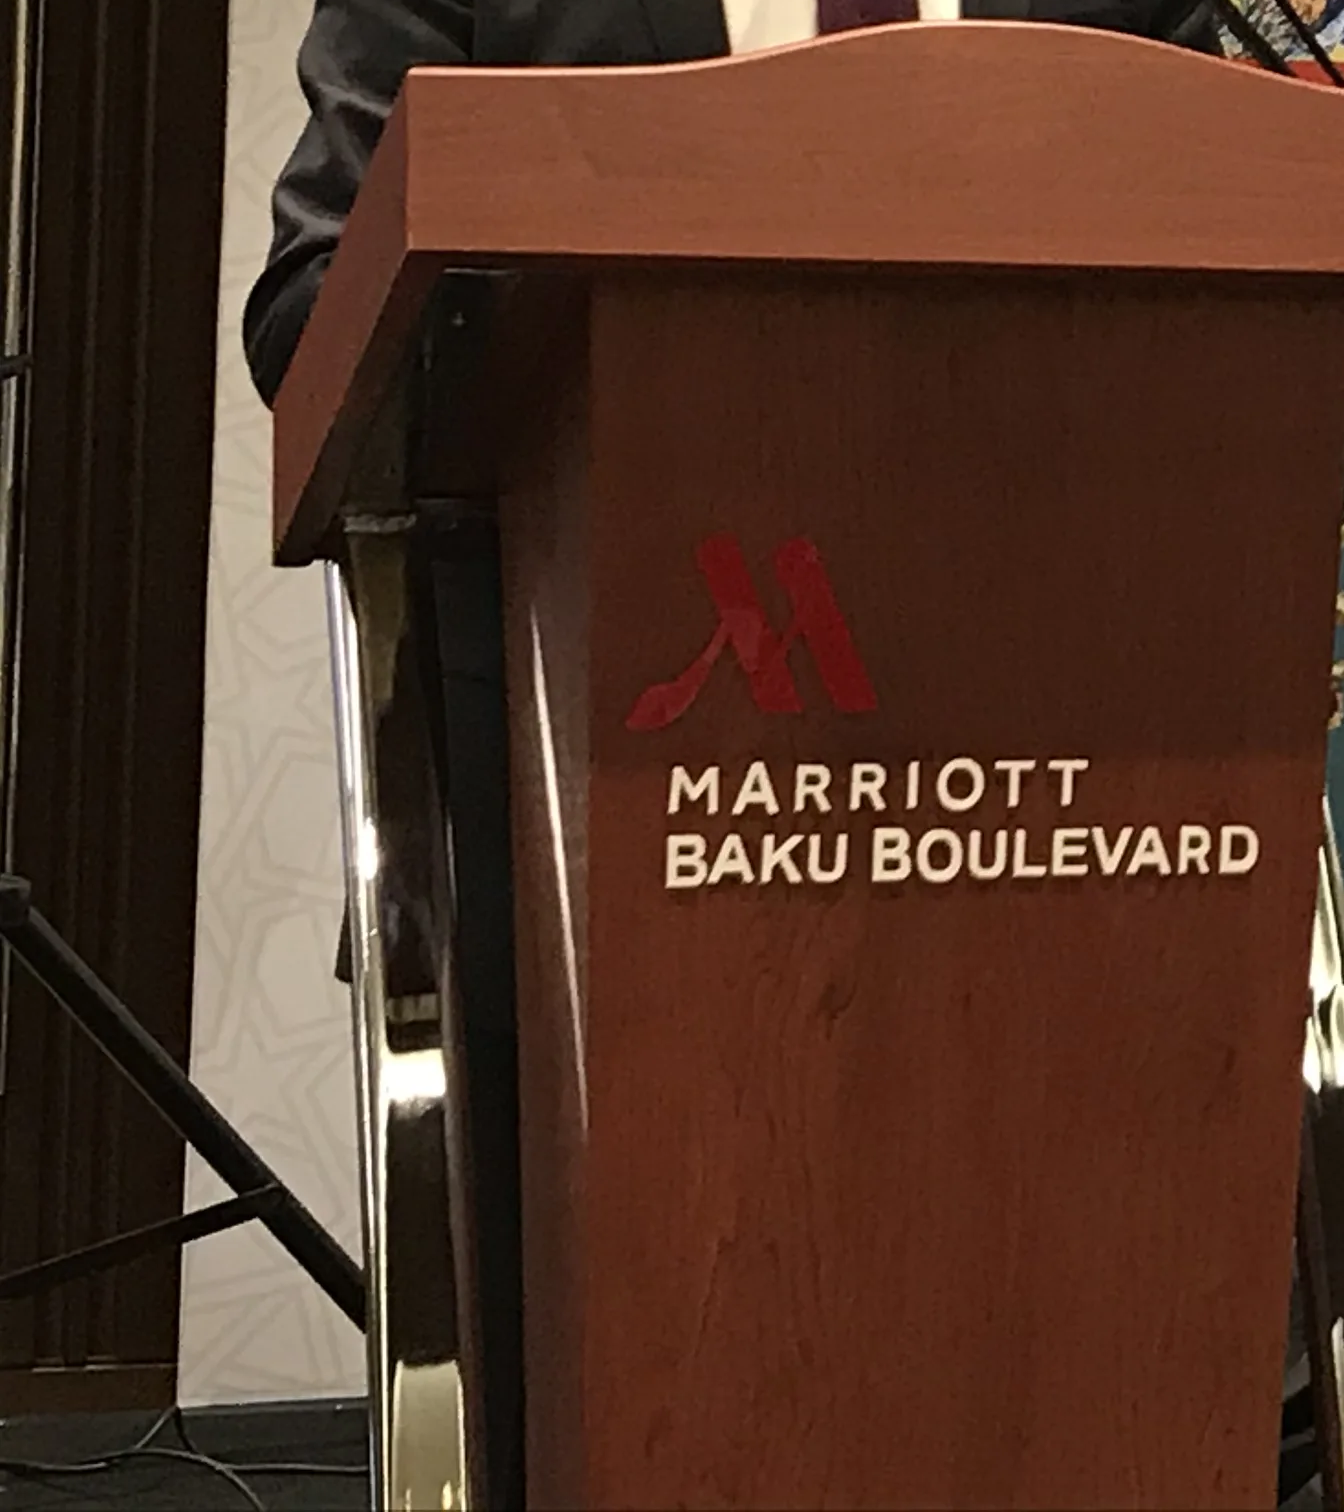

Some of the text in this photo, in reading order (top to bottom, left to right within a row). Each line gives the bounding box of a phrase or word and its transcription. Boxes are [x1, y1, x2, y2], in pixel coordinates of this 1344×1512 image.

[667, 757, 1089, 815] MARRIOTT
[665, 825, 1259, 889] BAKU BOULEVARD
